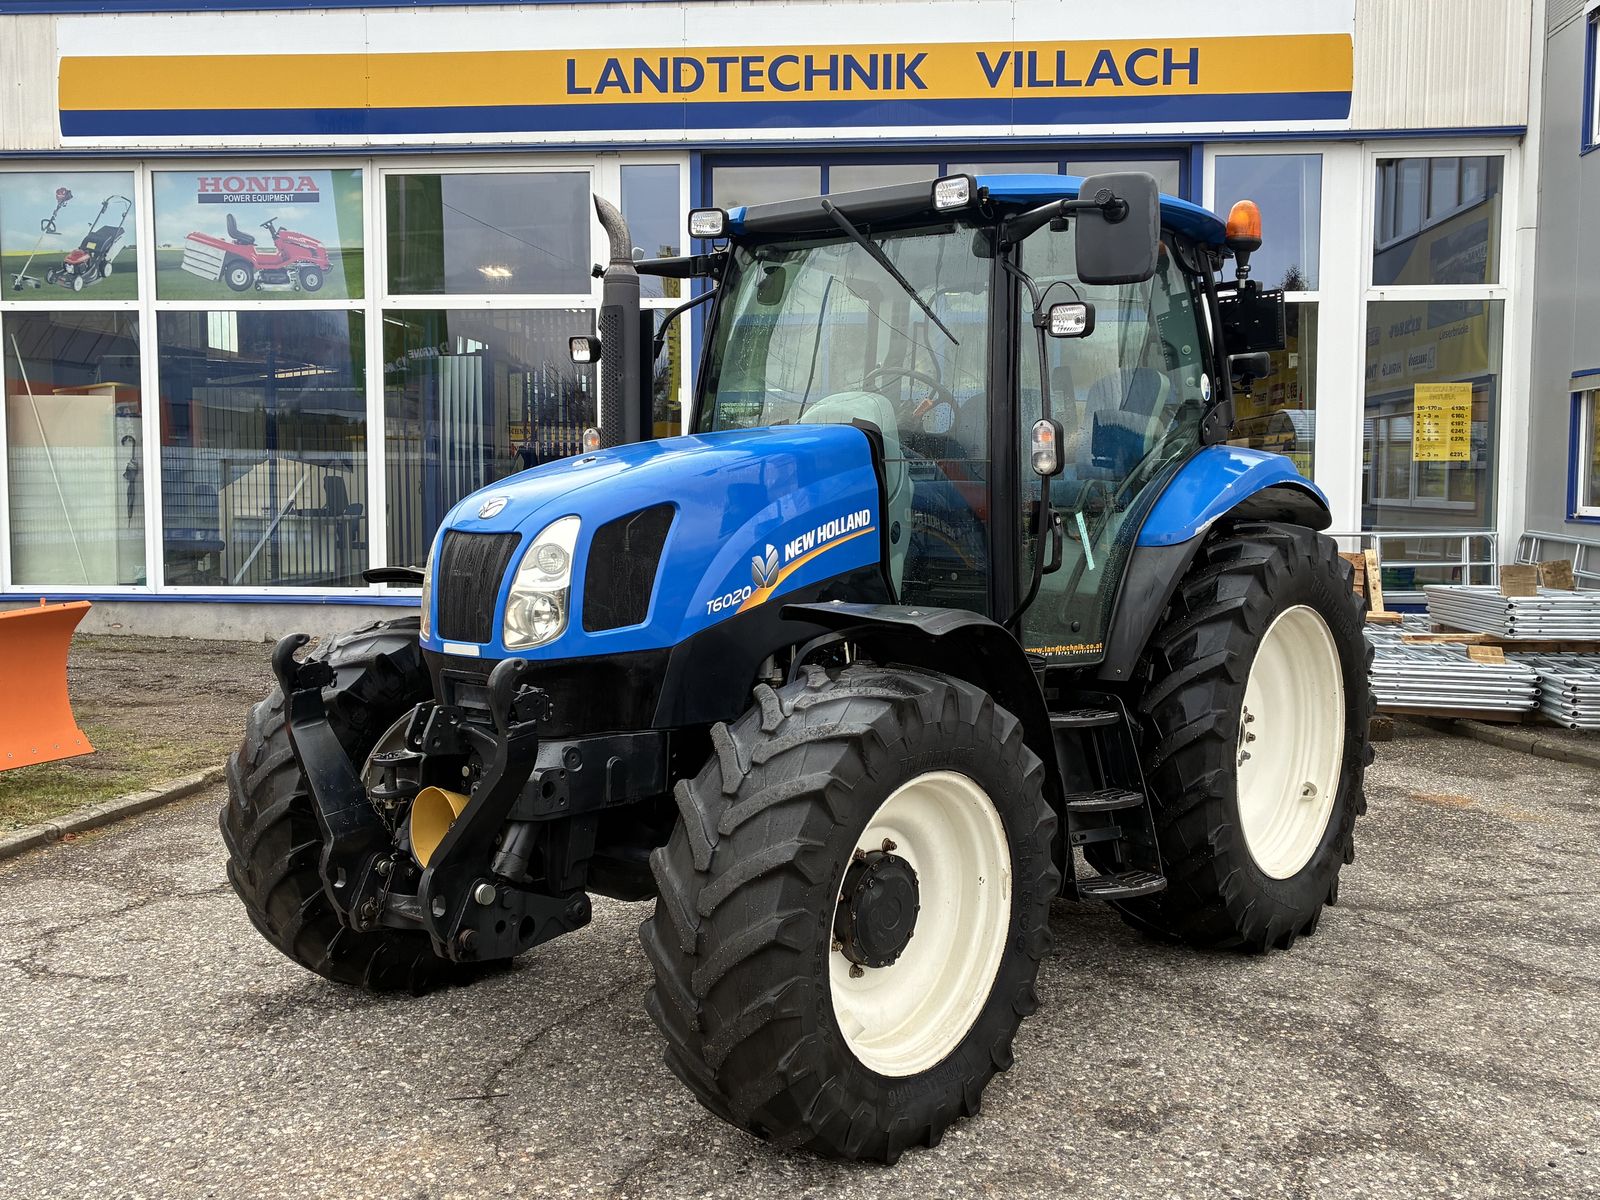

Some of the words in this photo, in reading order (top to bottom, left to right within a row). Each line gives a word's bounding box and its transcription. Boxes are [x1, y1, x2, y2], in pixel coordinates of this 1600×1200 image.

[566, 53, 929, 94] LANDTECHNIK
[976, 47, 1199, 89] VILLACH
[197, 175, 319, 192] HONDA
[223, 194, 251, 203] POWER
[252, 193, 294, 202] EQUIPMENT
[784, 529, 815, 562] NEW
[817, 508, 871, 544] HOLLAND
[706, 585, 752, 615] T6020
